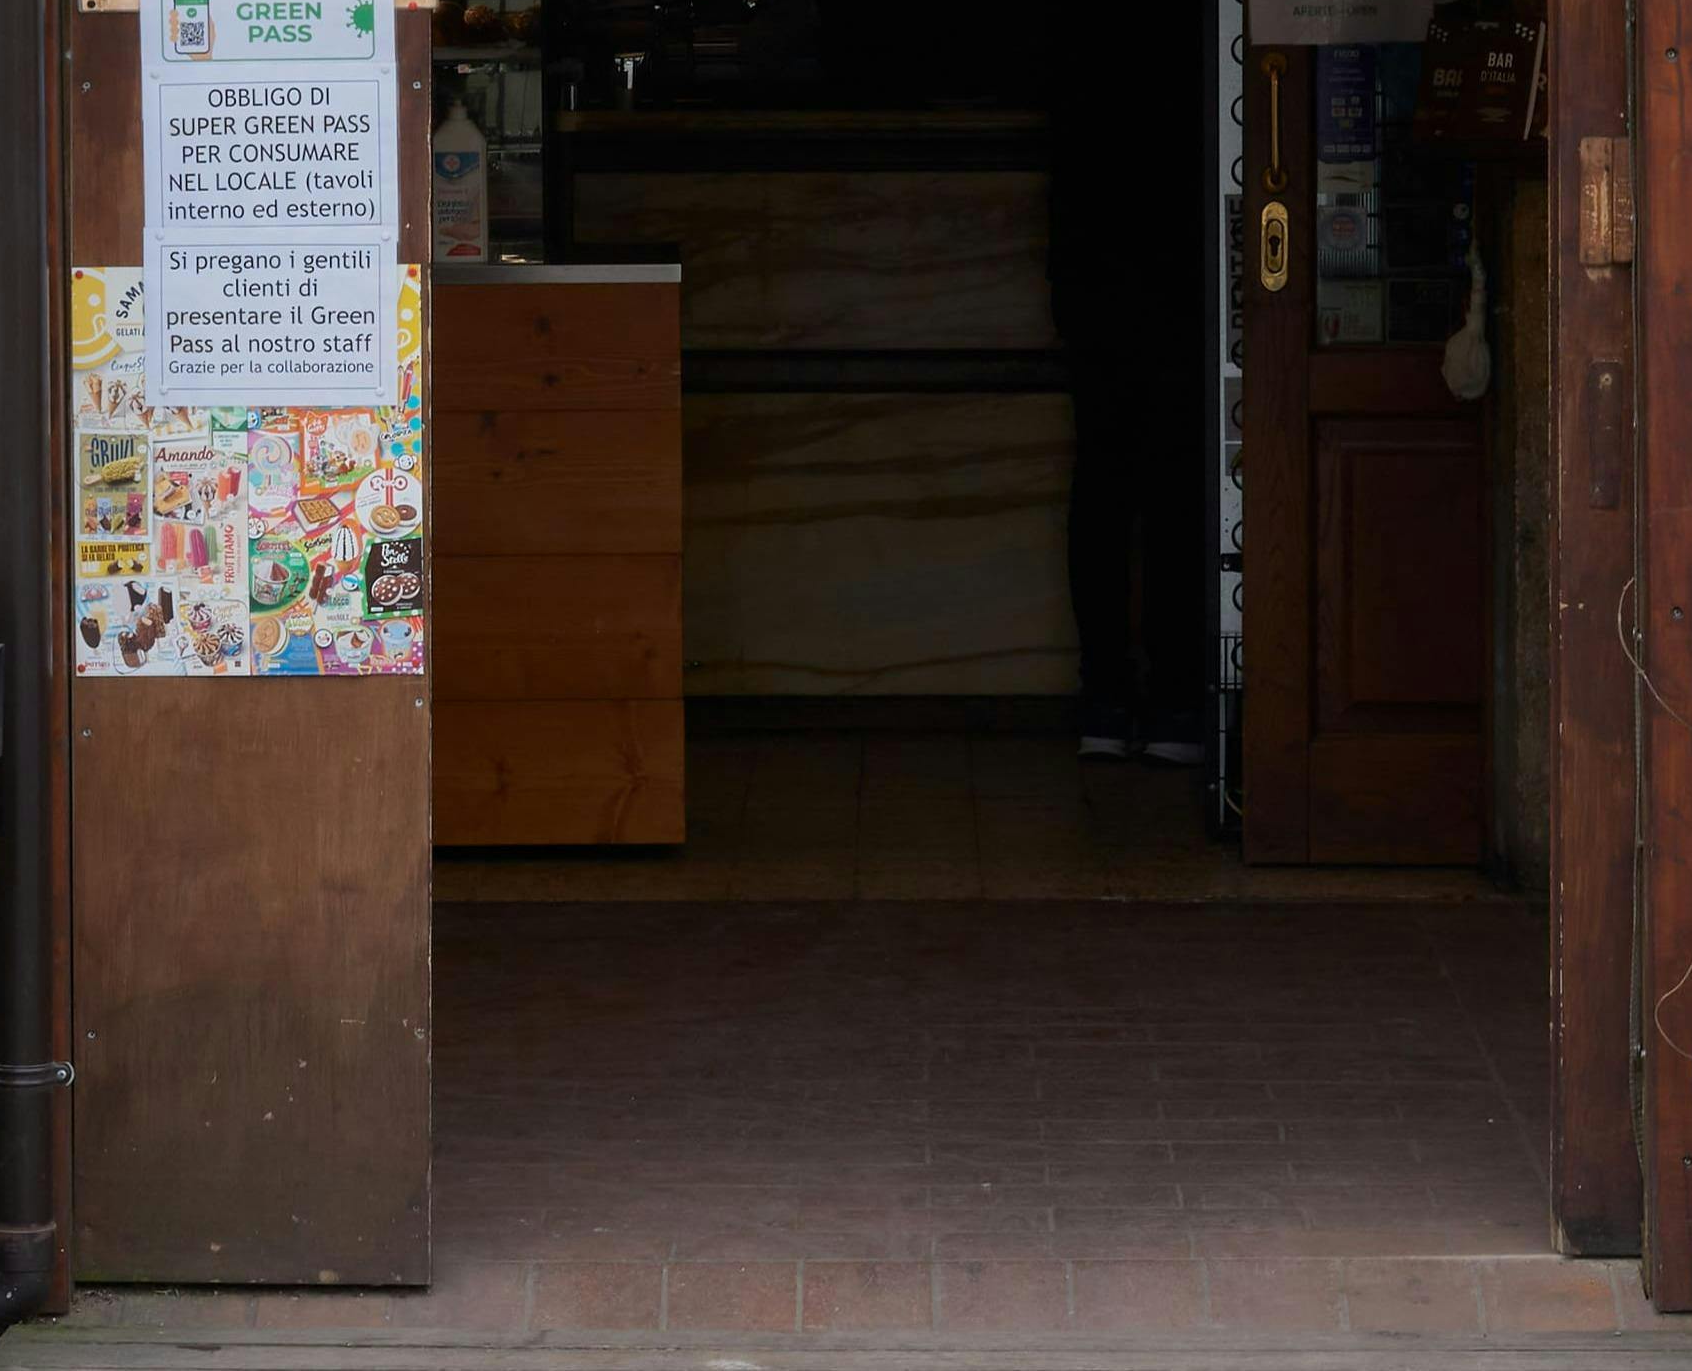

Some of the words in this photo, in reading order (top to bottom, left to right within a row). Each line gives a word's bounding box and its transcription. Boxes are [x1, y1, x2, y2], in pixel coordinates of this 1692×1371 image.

[236, 2, 322, 20] GREEN
[248, 25, 313, 43] PASS
[1487, 52, 1514, 68] BAR
[208, 88, 302, 107] OBBLIGO
[311, 87, 330, 105] DI
[170, 117, 236, 136] SUPER
[244, 116, 315, 135] GREEN
[324, 114, 371, 133] PASS
[182, 145, 221, 164] PER
[229, 143, 359, 163] CONSUMARE
[169, 174, 209, 192] NEL
[216, 172, 296, 191] LOCALE
[306, 170, 373, 193] (tavoli
[168, 202, 245, 220] interno
[252, 200, 278, 218] ed
[286, 199, 375, 221] esterno)
[170, 251, 187, 270] Si
[196, 254, 281, 274] pregano
[289, 250, 295, 268] i
[303, 249, 371, 273] gentili
[223, 278, 290, 297] clienti
[299, 278, 318, 297] di
[166, 310, 282, 329] presentare
[290, 306, 303, 324] il
[311, 306, 375, 325] Green
[115, 327, 141, 337] GELATI
[170, 335, 213, 353] Pass
[221, 334, 240, 353] al
[249, 336, 315, 353] nostro
[323, 333, 373, 352] staff
[169, 360, 215, 374] Grazie
[220, 362, 244, 376] per
[249, 359, 262, 373] la
[267, 359, 374, 374] collaborazione
[154, 446, 215, 463] Amando
